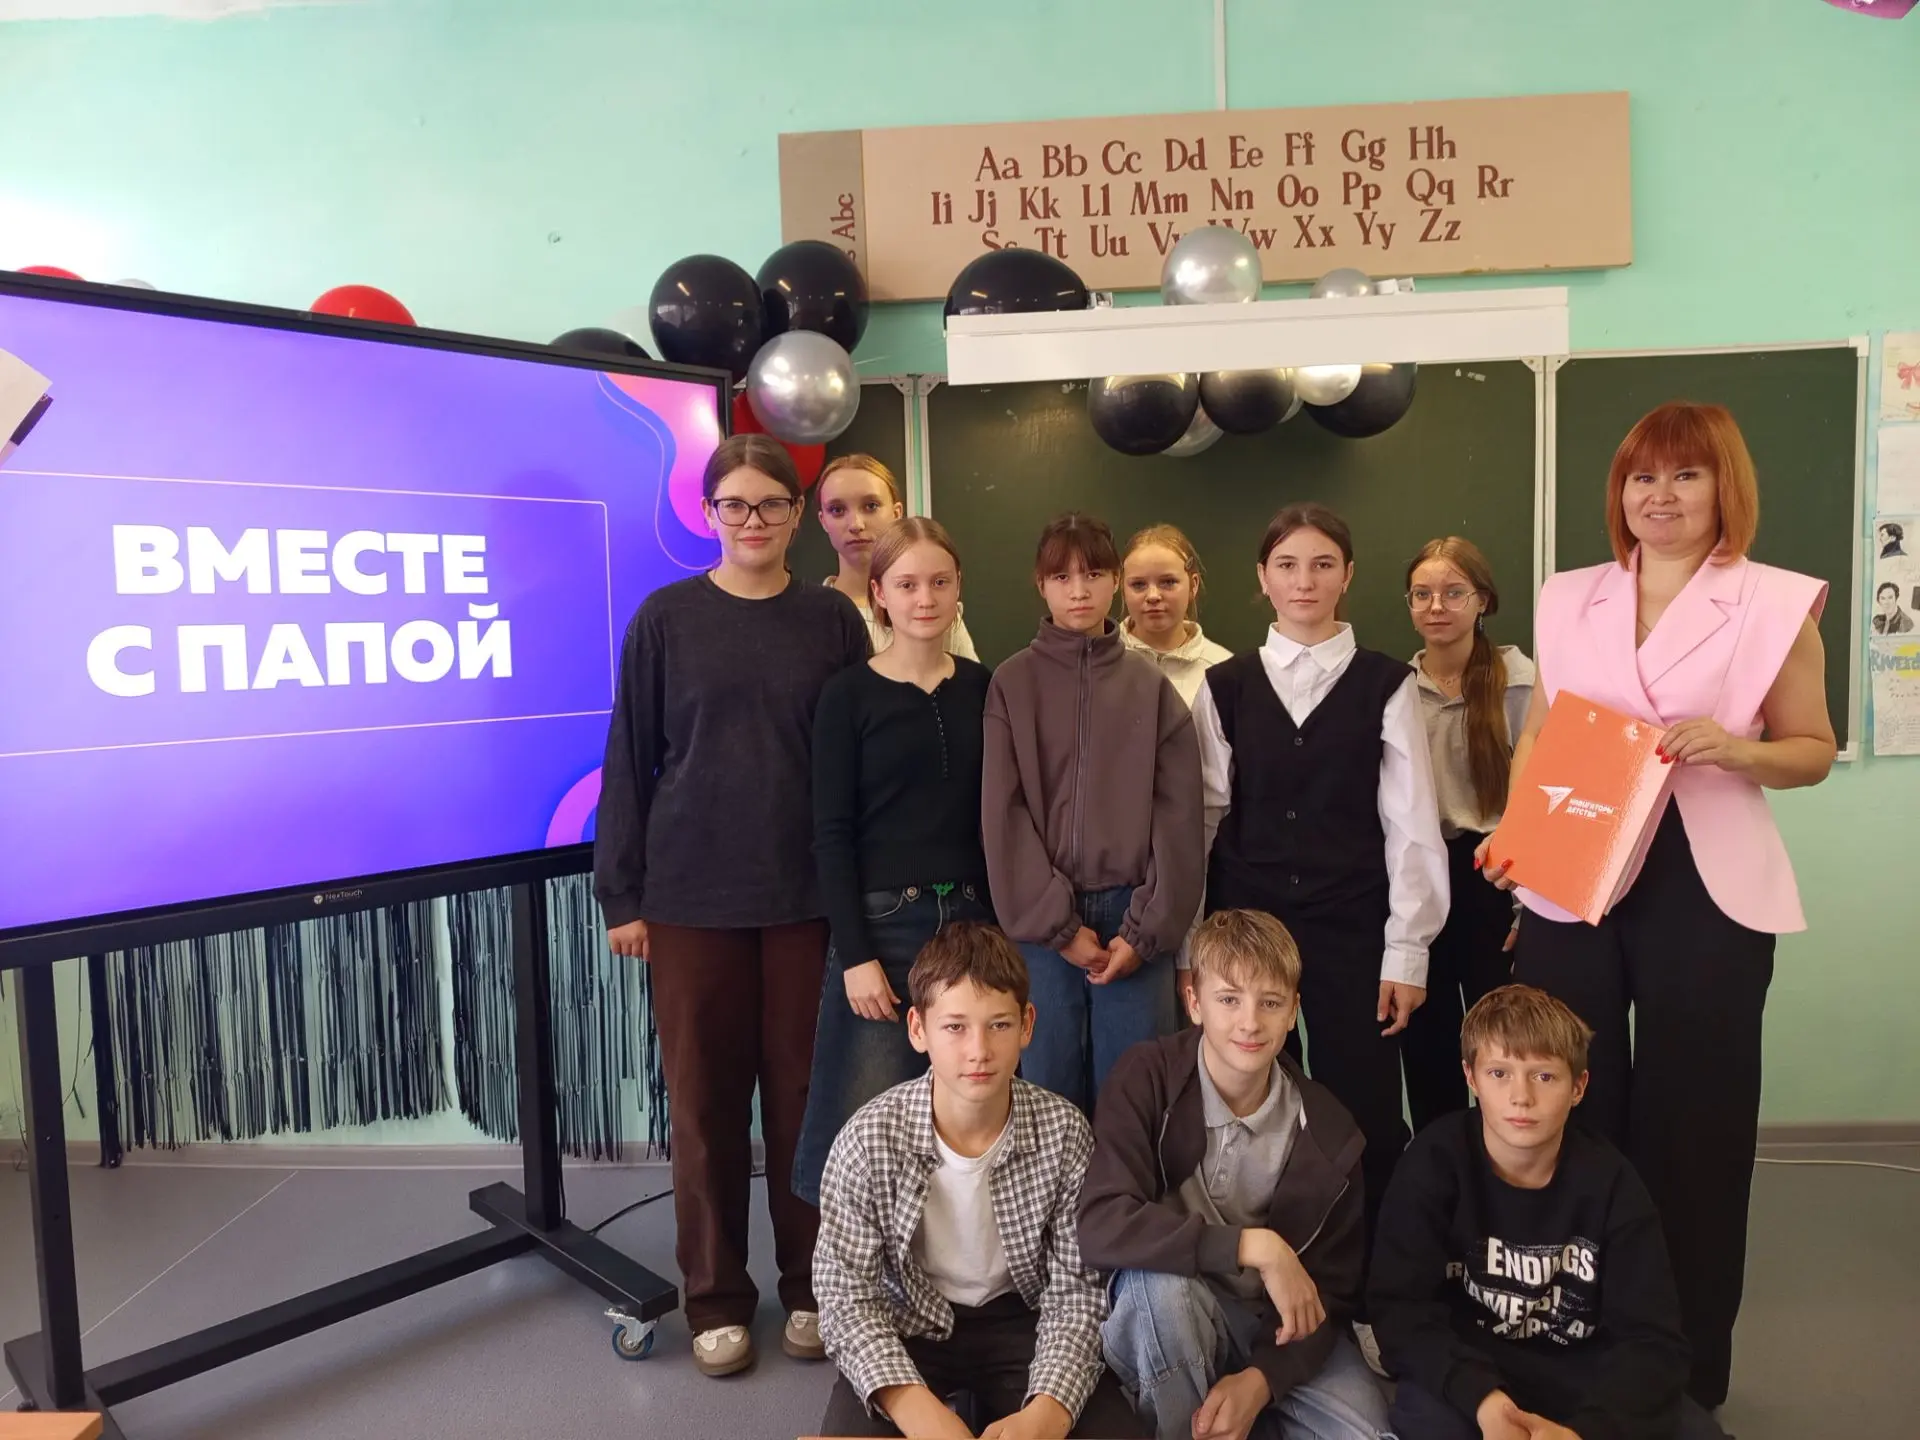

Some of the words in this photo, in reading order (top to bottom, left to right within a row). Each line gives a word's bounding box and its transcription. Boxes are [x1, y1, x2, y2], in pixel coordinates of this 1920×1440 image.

[975, 146, 1022, 181] Aa
[1042, 144, 1087, 178] Bb
[1102, 140, 1142, 175] Cc
[1165, 137, 1208, 172] Dd
[1229, 135, 1263, 169] Ee
[1285, 132, 1315, 166] Ff
[1341, 129, 1386, 171] Gg
[1409, 126, 1456, 160] Hh
[830, 193, 856, 241] Abc
[932, 192, 952, 224] Ii
[968, 189, 997, 227] Jj
[1020, 186, 1061, 220] Kk
[1082, 183, 1111, 217] Ll
[1130, 181, 1188, 215] Mm
[1211, 177, 1253, 211] Nn
[1277, 174, 1319, 208] Oo
[1342, 171, 1382, 209] Pp
[1406, 168, 1455, 206] Qq
[1478, 165, 1514, 198] Rr
[1034, 227, 1068, 259] Tt
[1090, 224, 1129, 257] Uu
[1293, 214, 1336, 248] Xx
[1354, 211, 1396, 250] Yy
[1419, 208, 1462, 243] Zz
[112, 524, 489, 596] ВМЕСТЕ
[86, 624, 155, 697] С
[177, 602, 513, 692] ПАПОЙ
